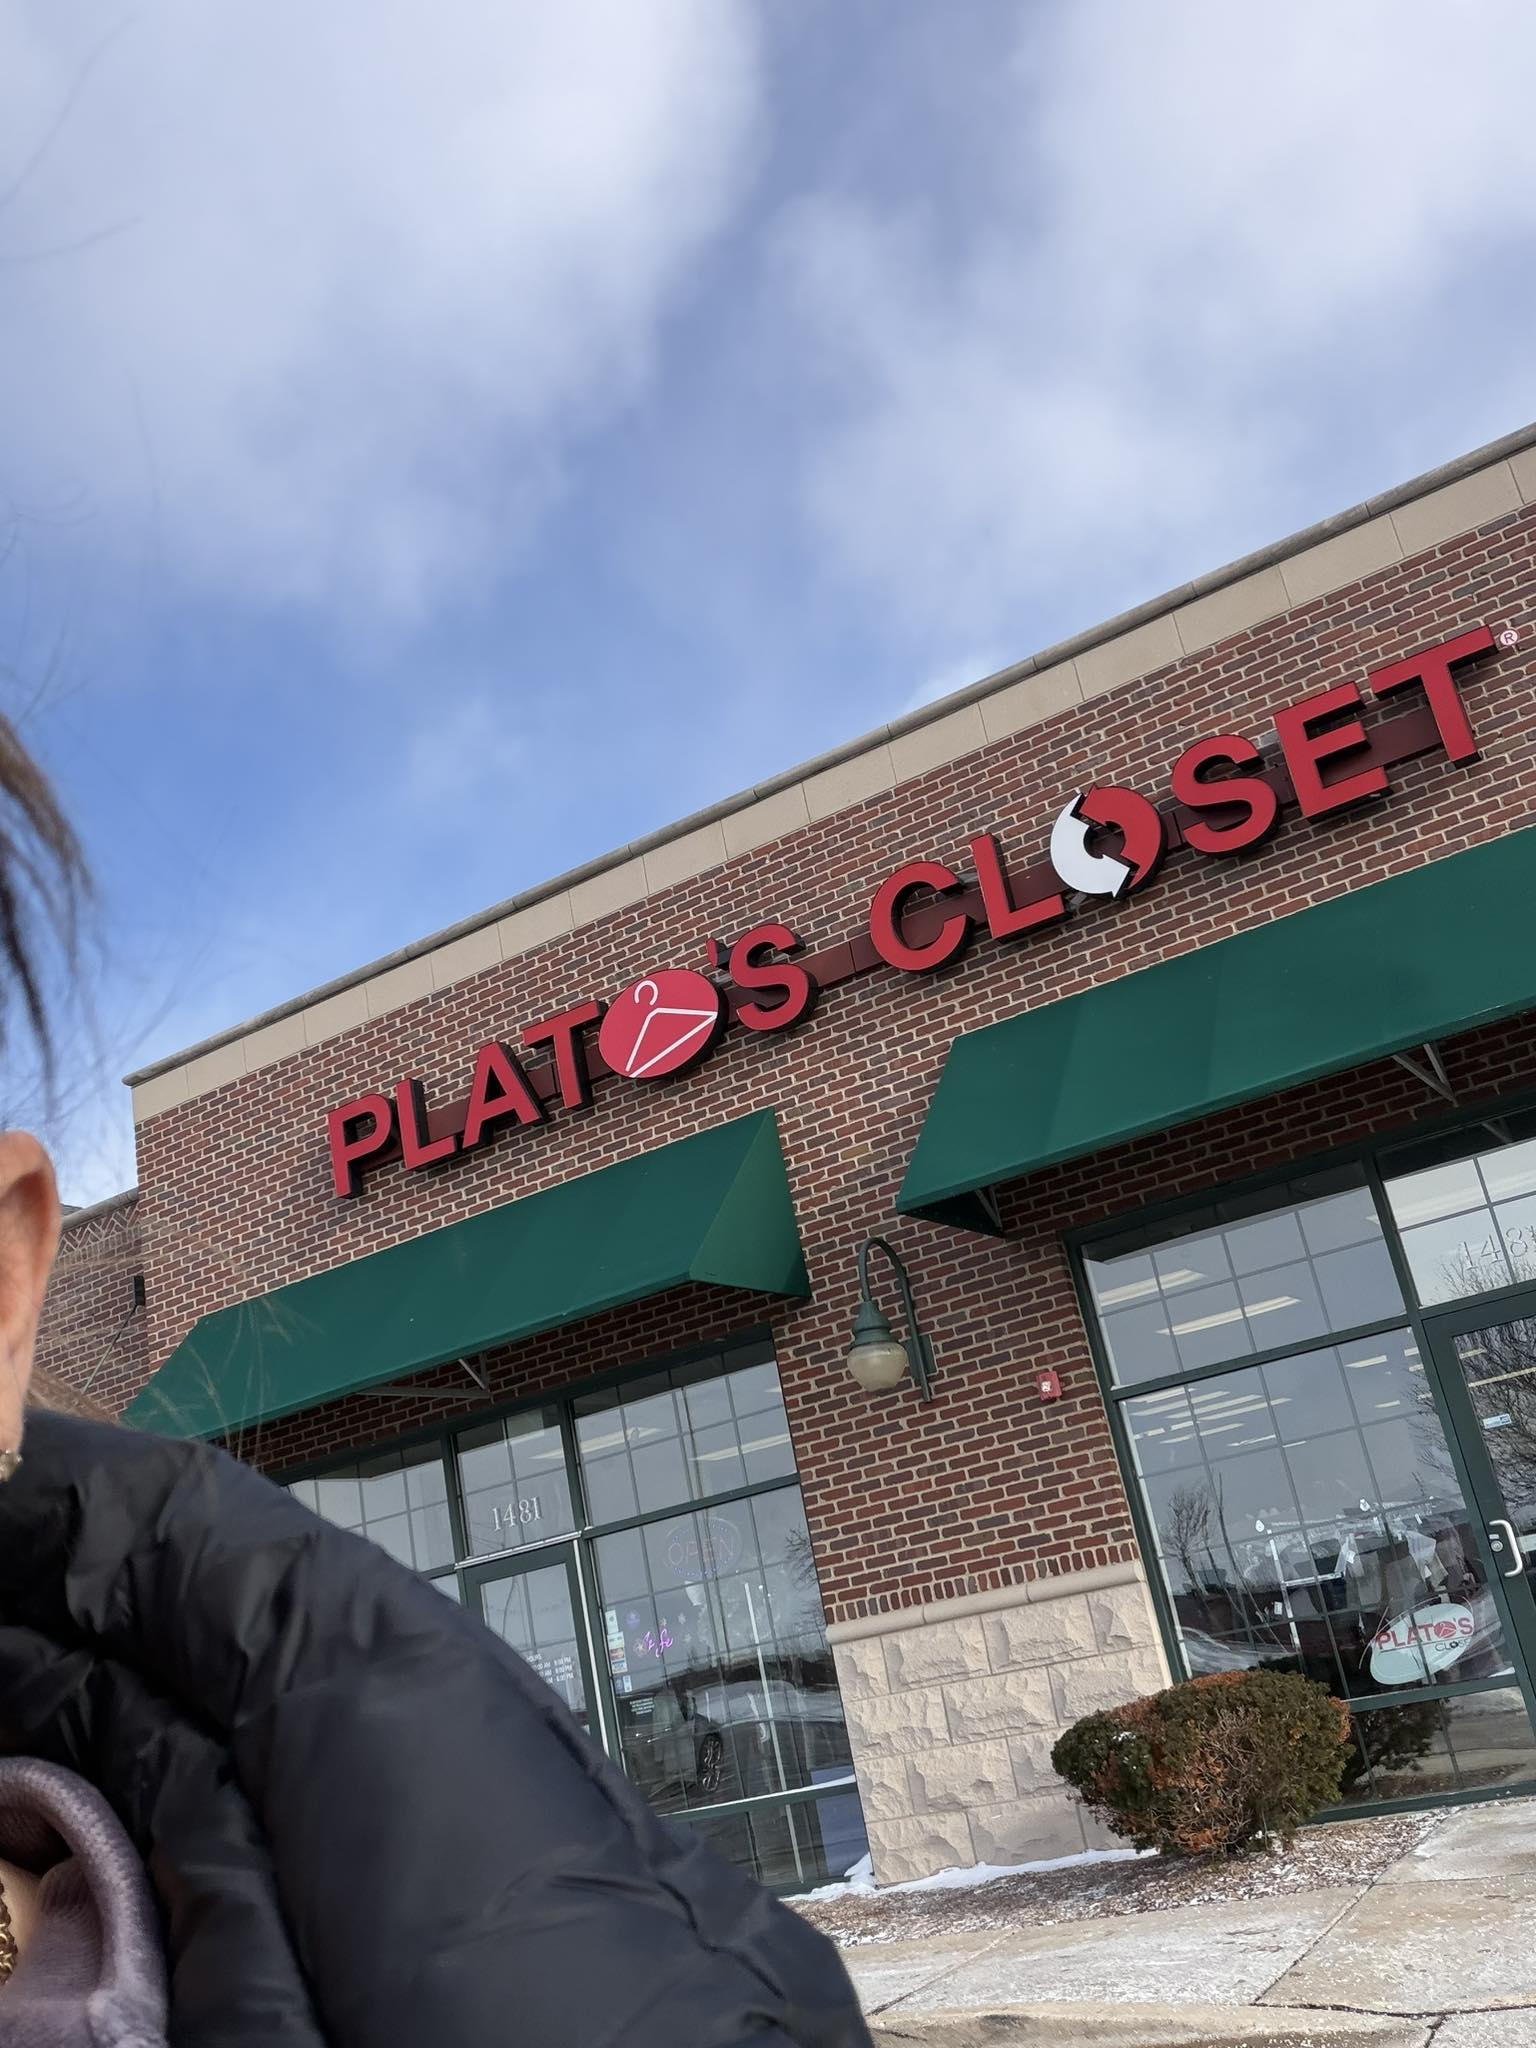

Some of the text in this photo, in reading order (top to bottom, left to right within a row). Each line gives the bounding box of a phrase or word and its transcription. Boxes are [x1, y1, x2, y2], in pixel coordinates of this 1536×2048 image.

[327, 923, 816, 1199] PLATO'S
[870, 625, 1495, 973] CLOSET
[491, 1497, 541, 1532] 1481
[1376, 1617, 1473, 1650] PLATO'S
